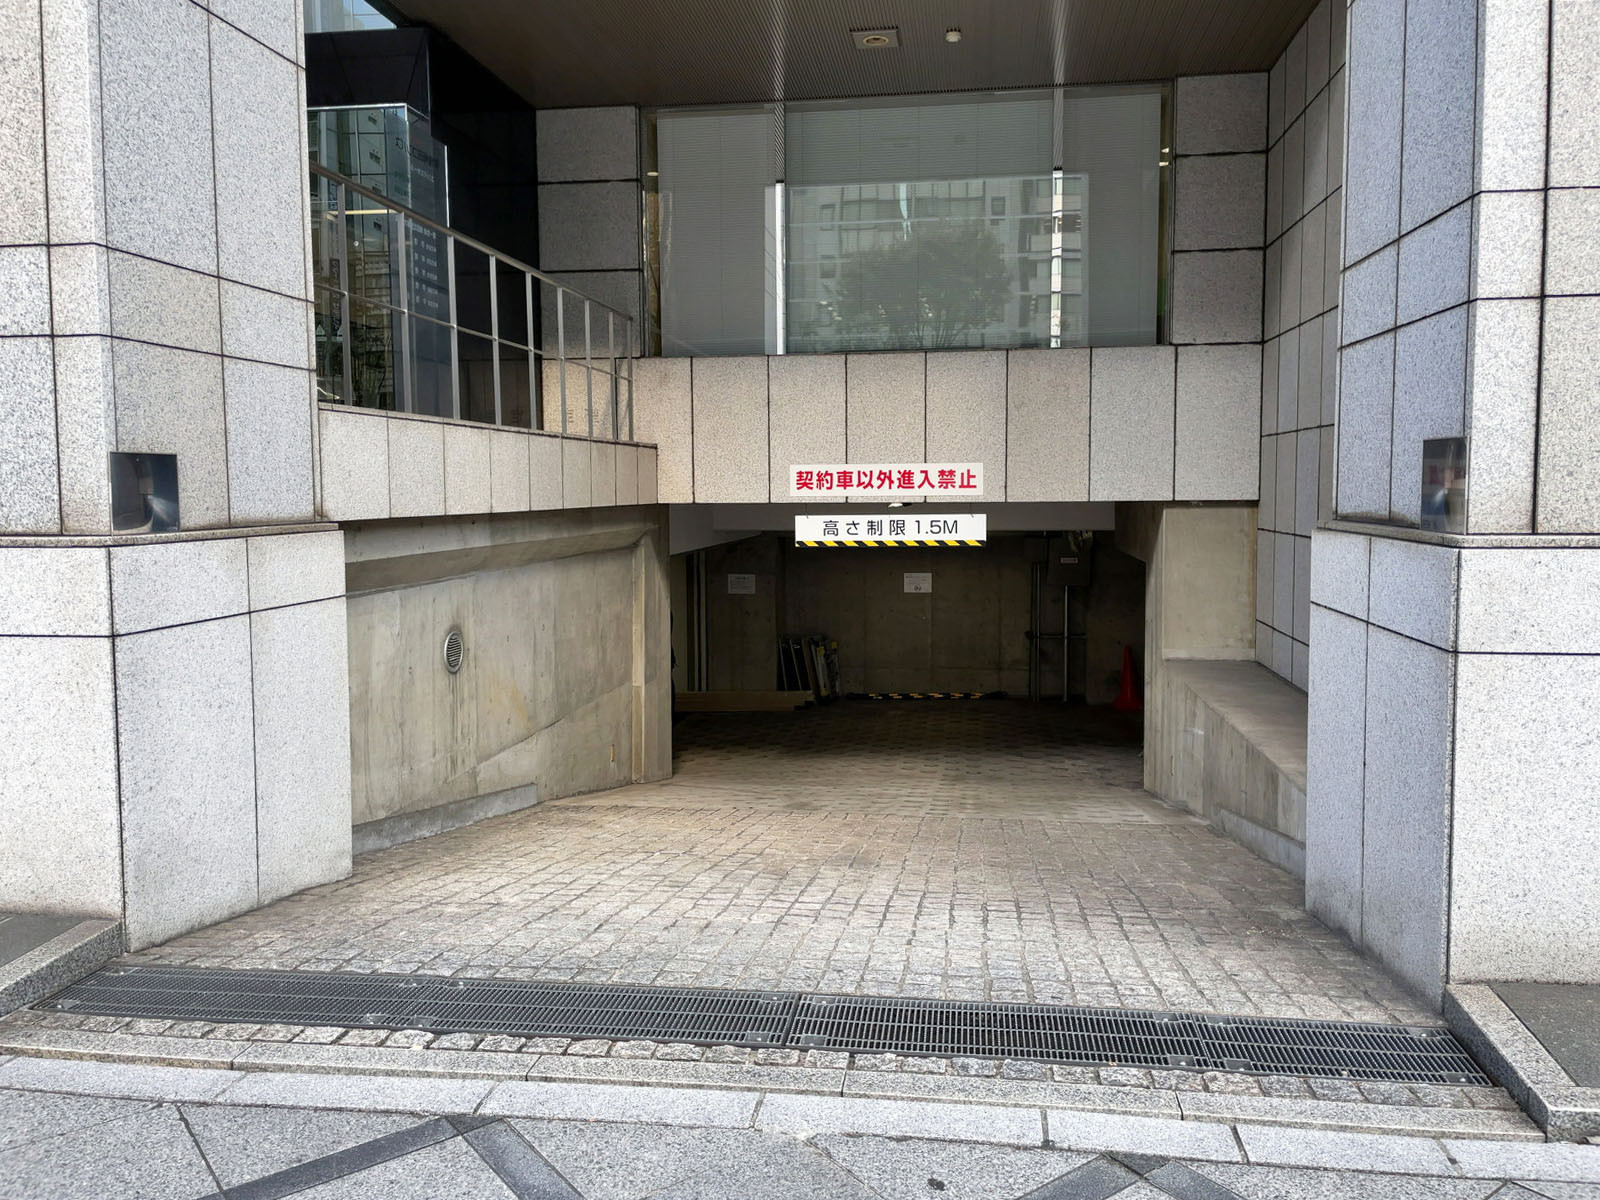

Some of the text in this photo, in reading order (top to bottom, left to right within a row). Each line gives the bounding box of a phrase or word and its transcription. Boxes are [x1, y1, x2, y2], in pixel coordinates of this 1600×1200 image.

[796, 469, 977, 490] 契約車以外進入禁止
